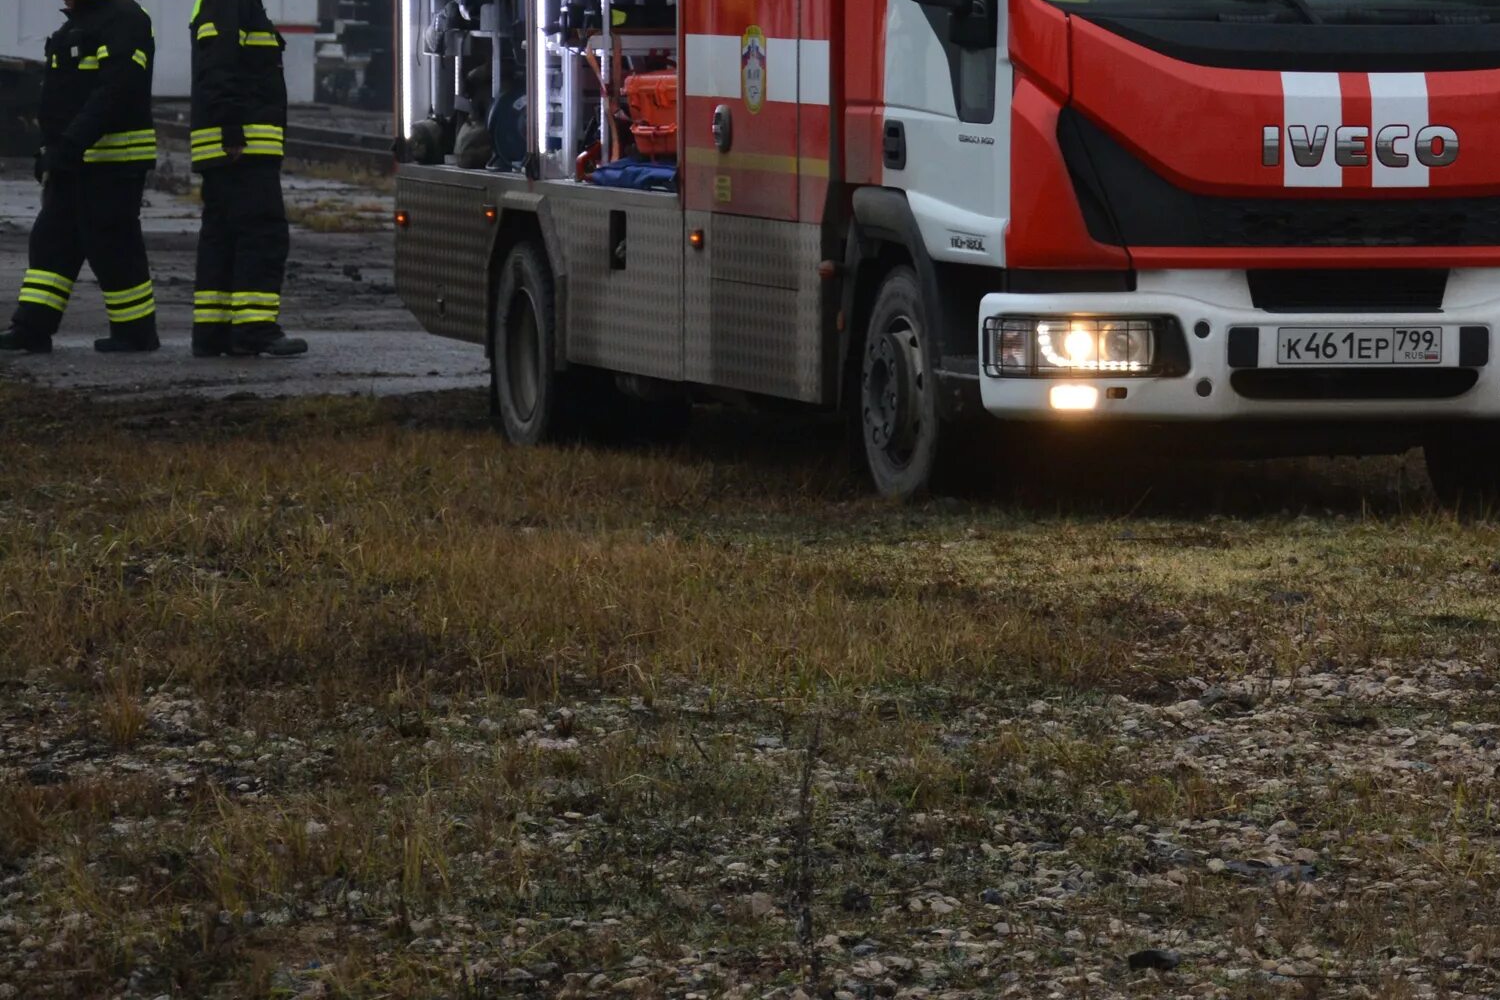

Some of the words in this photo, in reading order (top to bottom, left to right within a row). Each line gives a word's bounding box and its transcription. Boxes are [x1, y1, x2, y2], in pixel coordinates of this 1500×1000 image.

[1262, 124, 1460, 168] IVECO
[1396, 330, 1435, 351] 799
[1404, 351, 1424, 360] RUS
